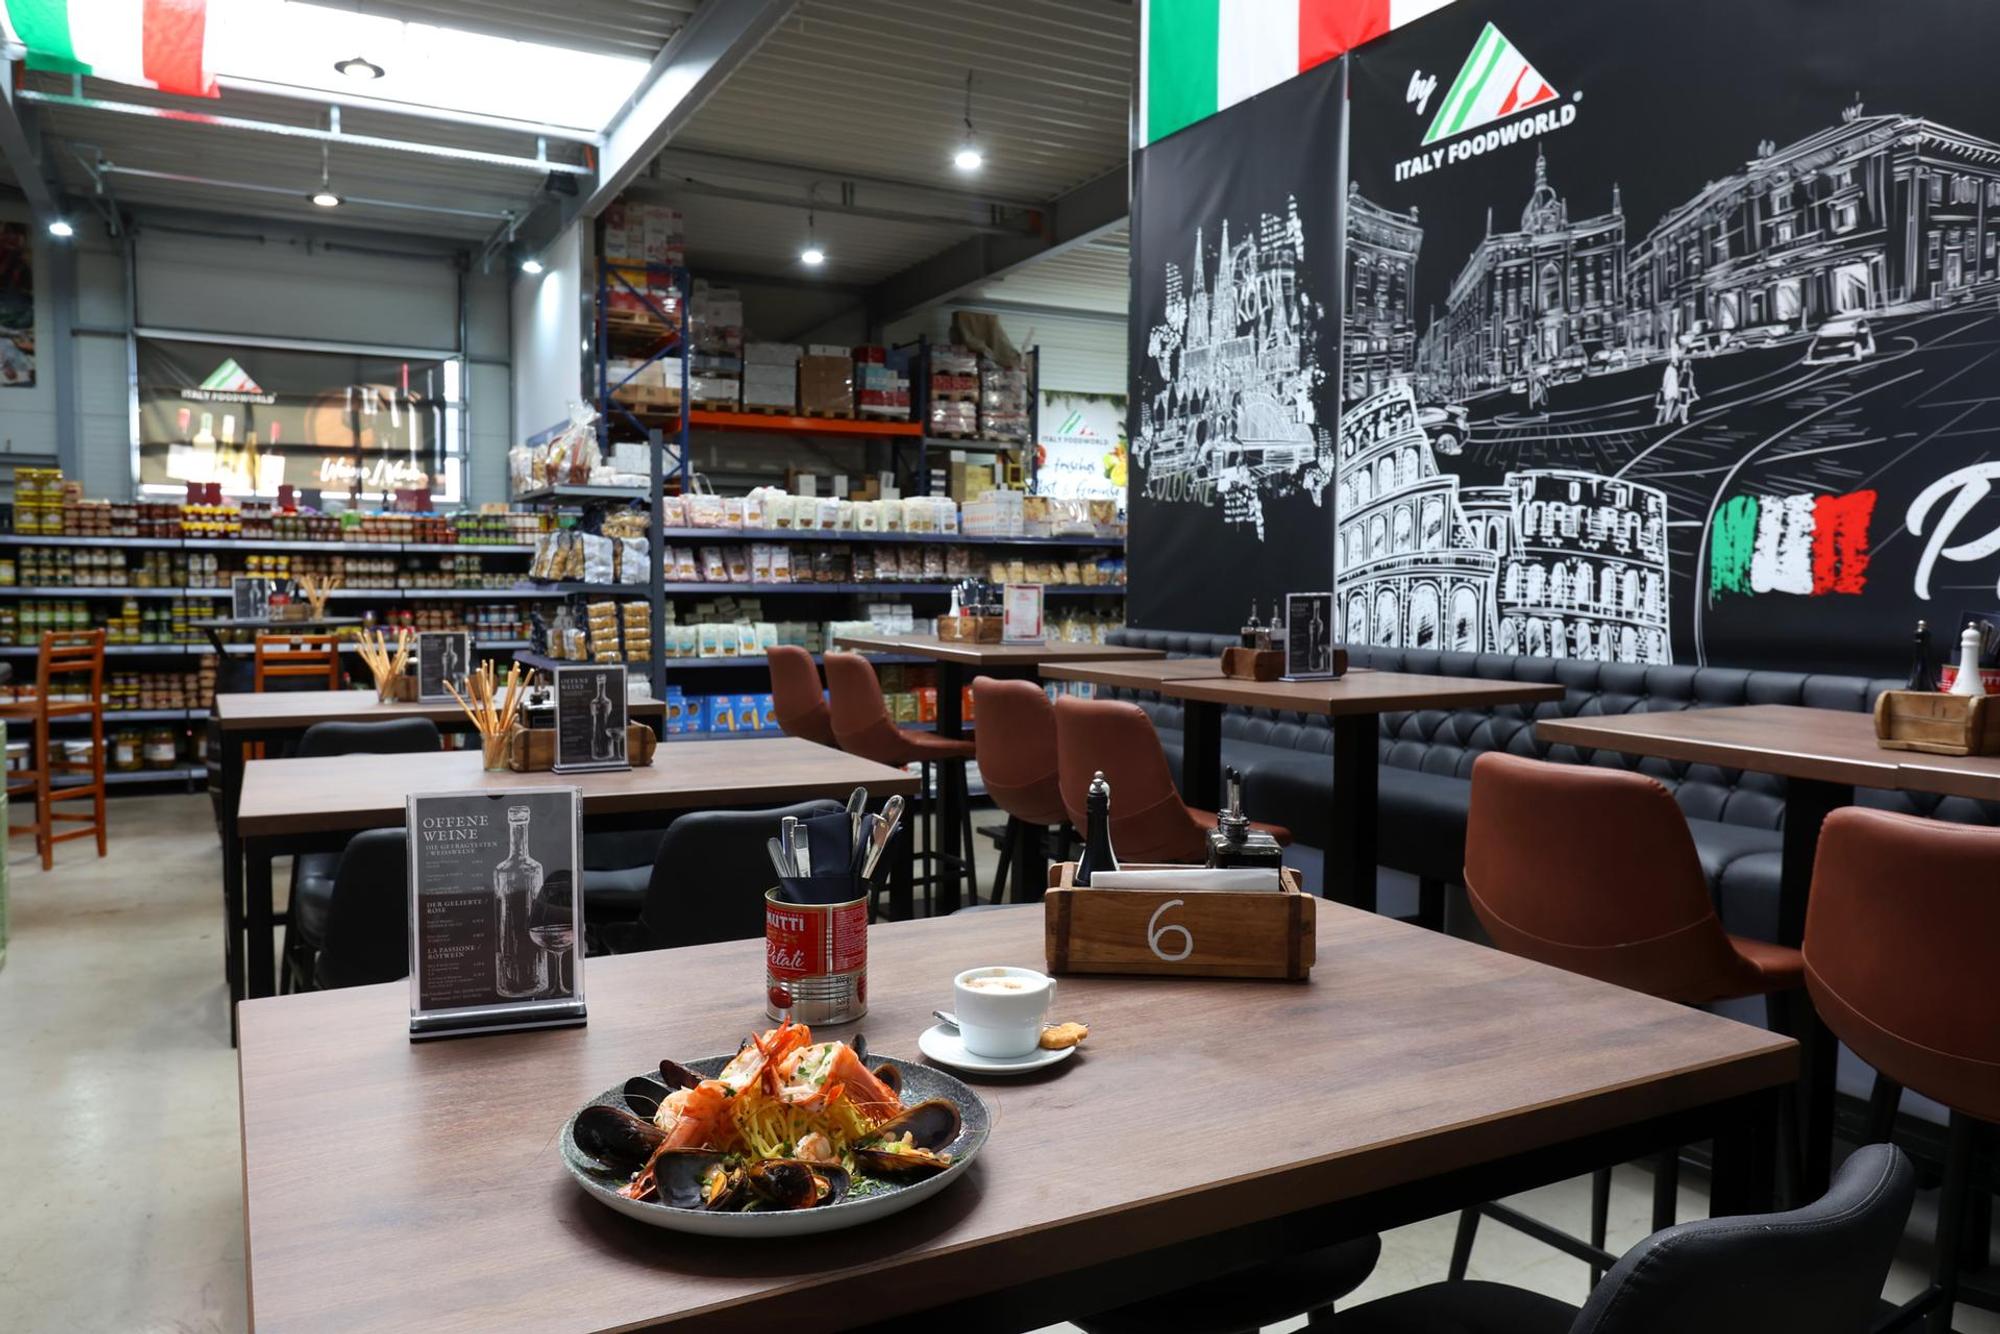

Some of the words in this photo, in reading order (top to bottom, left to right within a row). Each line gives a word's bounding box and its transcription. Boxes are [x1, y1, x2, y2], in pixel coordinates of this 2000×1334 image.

[1406, 69, 1437, 115] by
[1395, 148, 1445, 182] ITALY
[1447, 103, 1577, 165] FOODWORLD
[180, 388, 211, 401] ITALY
[211, 391, 276, 405] FOODWORLD
[422, 815, 489, 829] OFFENE
[423, 829, 479, 842] WEINE
[1147, 899, 1194, 961] 6
